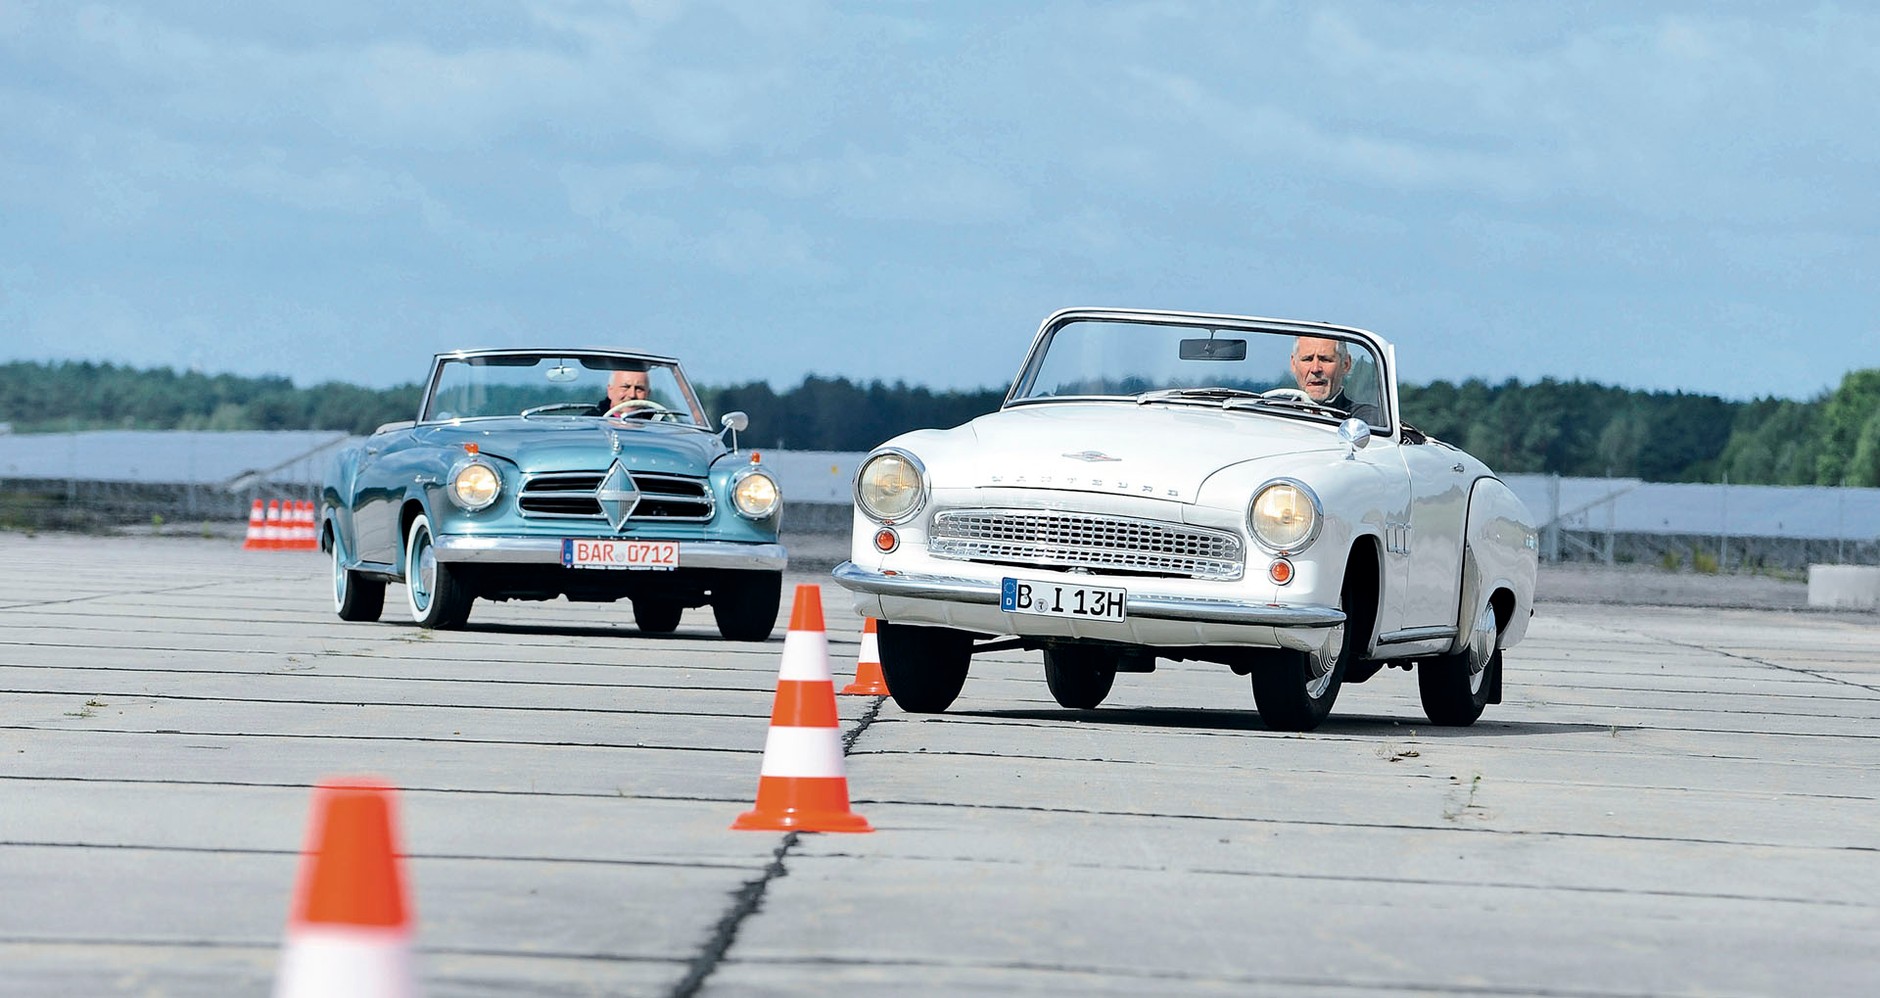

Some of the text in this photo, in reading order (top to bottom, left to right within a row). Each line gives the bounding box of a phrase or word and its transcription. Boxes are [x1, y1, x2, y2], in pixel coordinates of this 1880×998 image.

[577, 543, 614, 562] BAR
[627, 544, 674, 563] 0712
[1017, 584, 1032, 608] B
[1072, 589, 1124, 617] 13H
